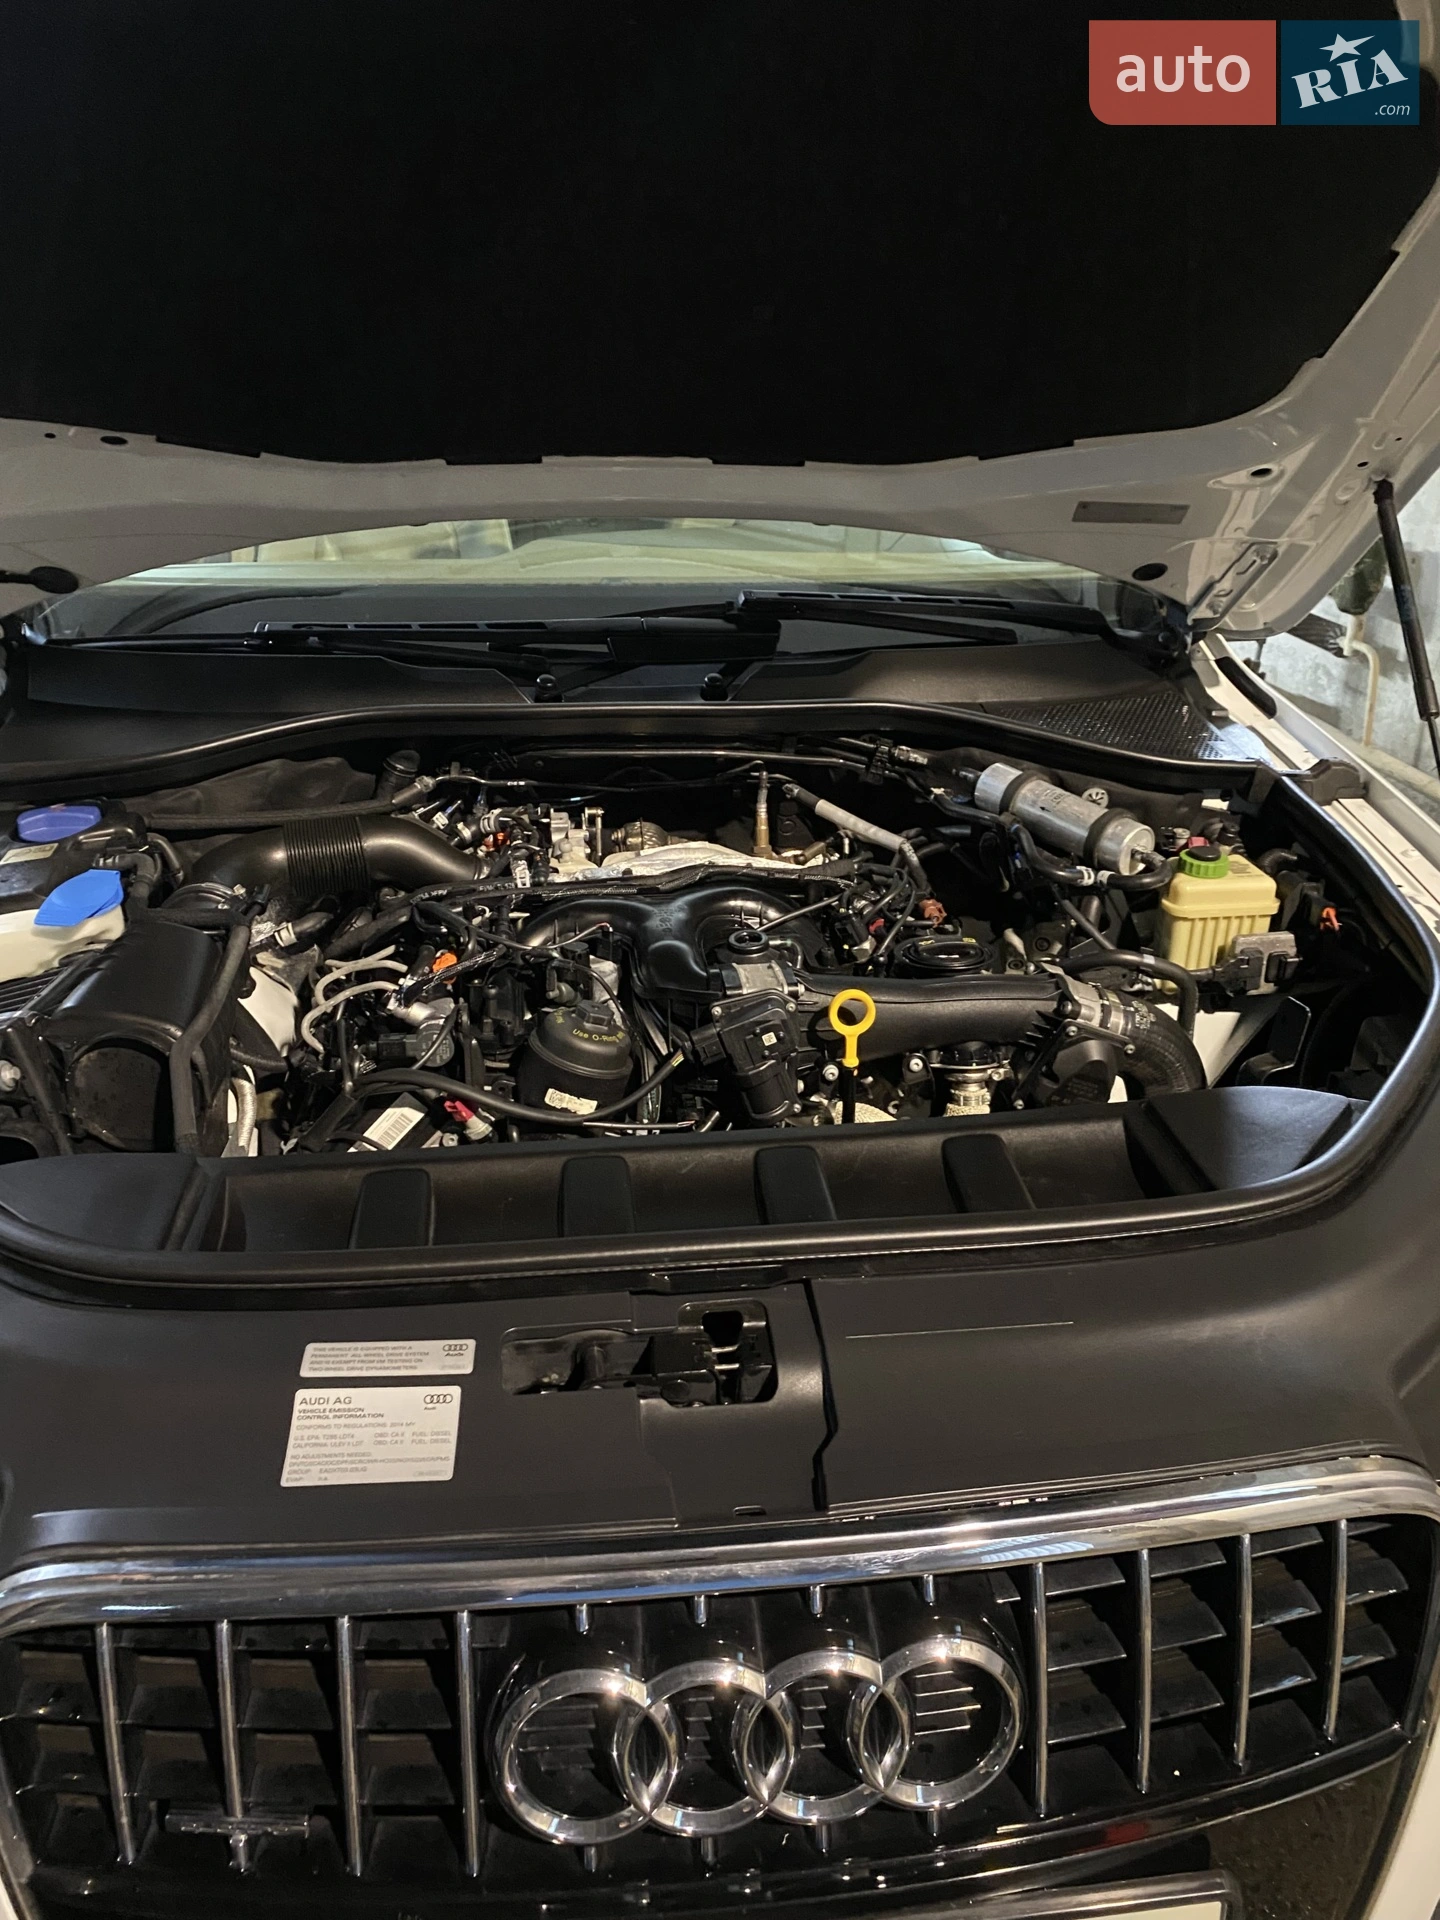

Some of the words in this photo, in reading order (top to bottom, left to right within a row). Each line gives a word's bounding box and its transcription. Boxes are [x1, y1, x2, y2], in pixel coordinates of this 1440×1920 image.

[572, 1028, 589, 1038] Use
[299, 1397, 330, 1406] AUDI
[333, 1396, 352, 1405] AG
